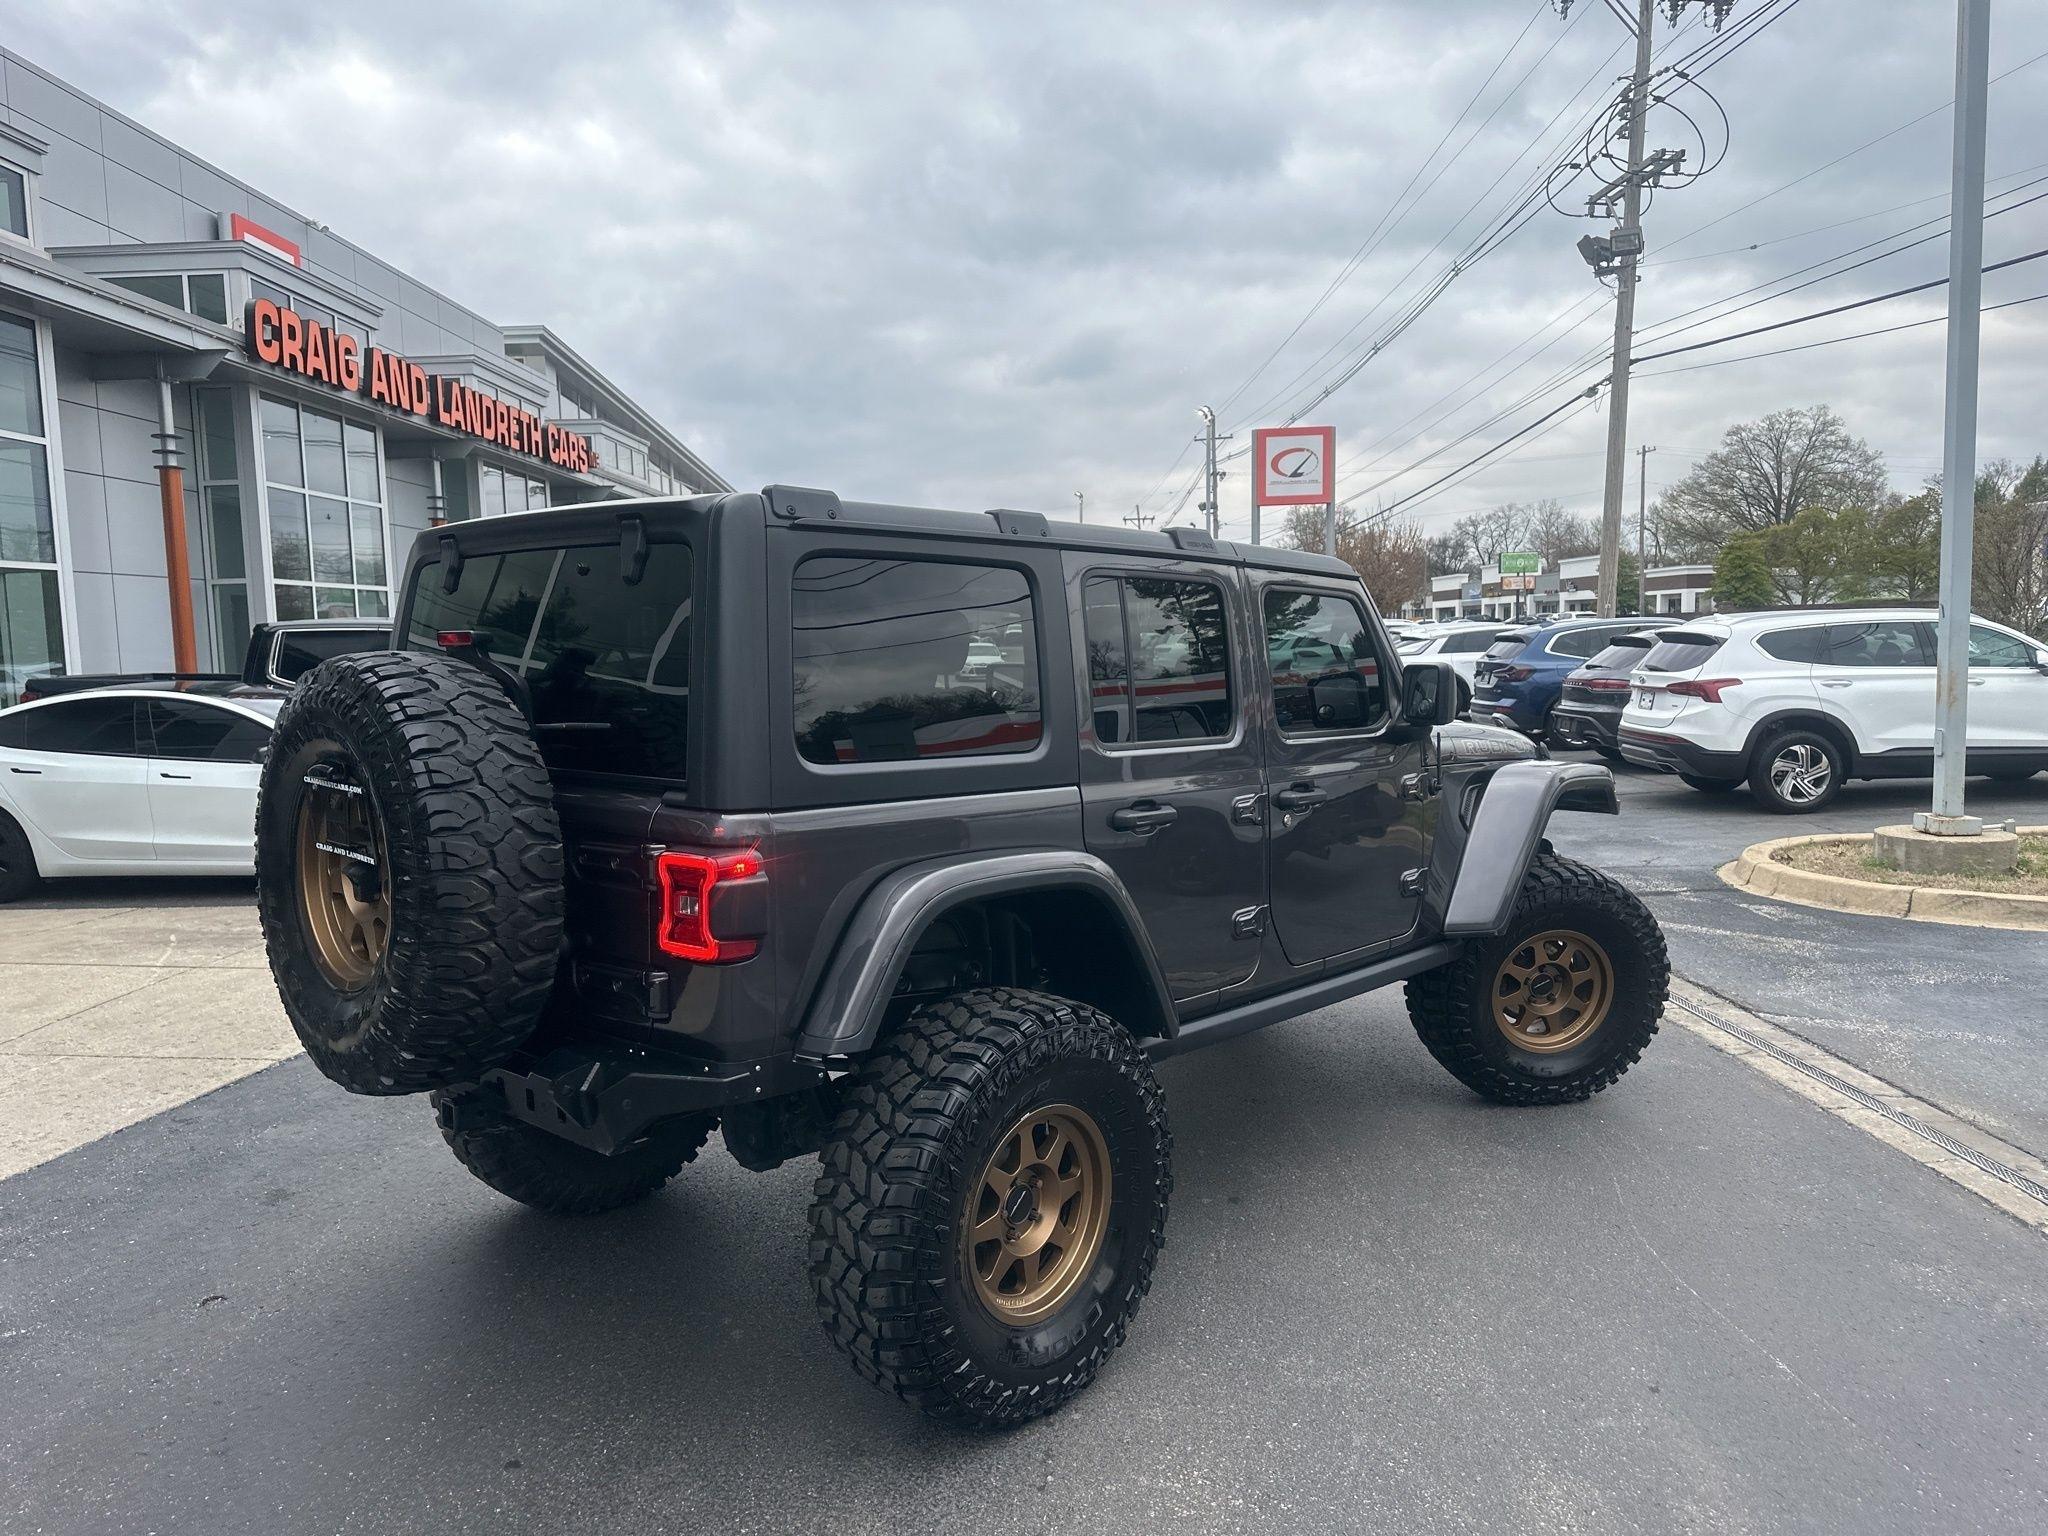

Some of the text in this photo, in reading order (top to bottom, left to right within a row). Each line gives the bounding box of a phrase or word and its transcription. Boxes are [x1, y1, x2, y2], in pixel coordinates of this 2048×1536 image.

[253, 298, 588, 474] CRAIG AND LANDRETH CARS
[316, 842, 375, 865] CRAIG AND LANDRETH
